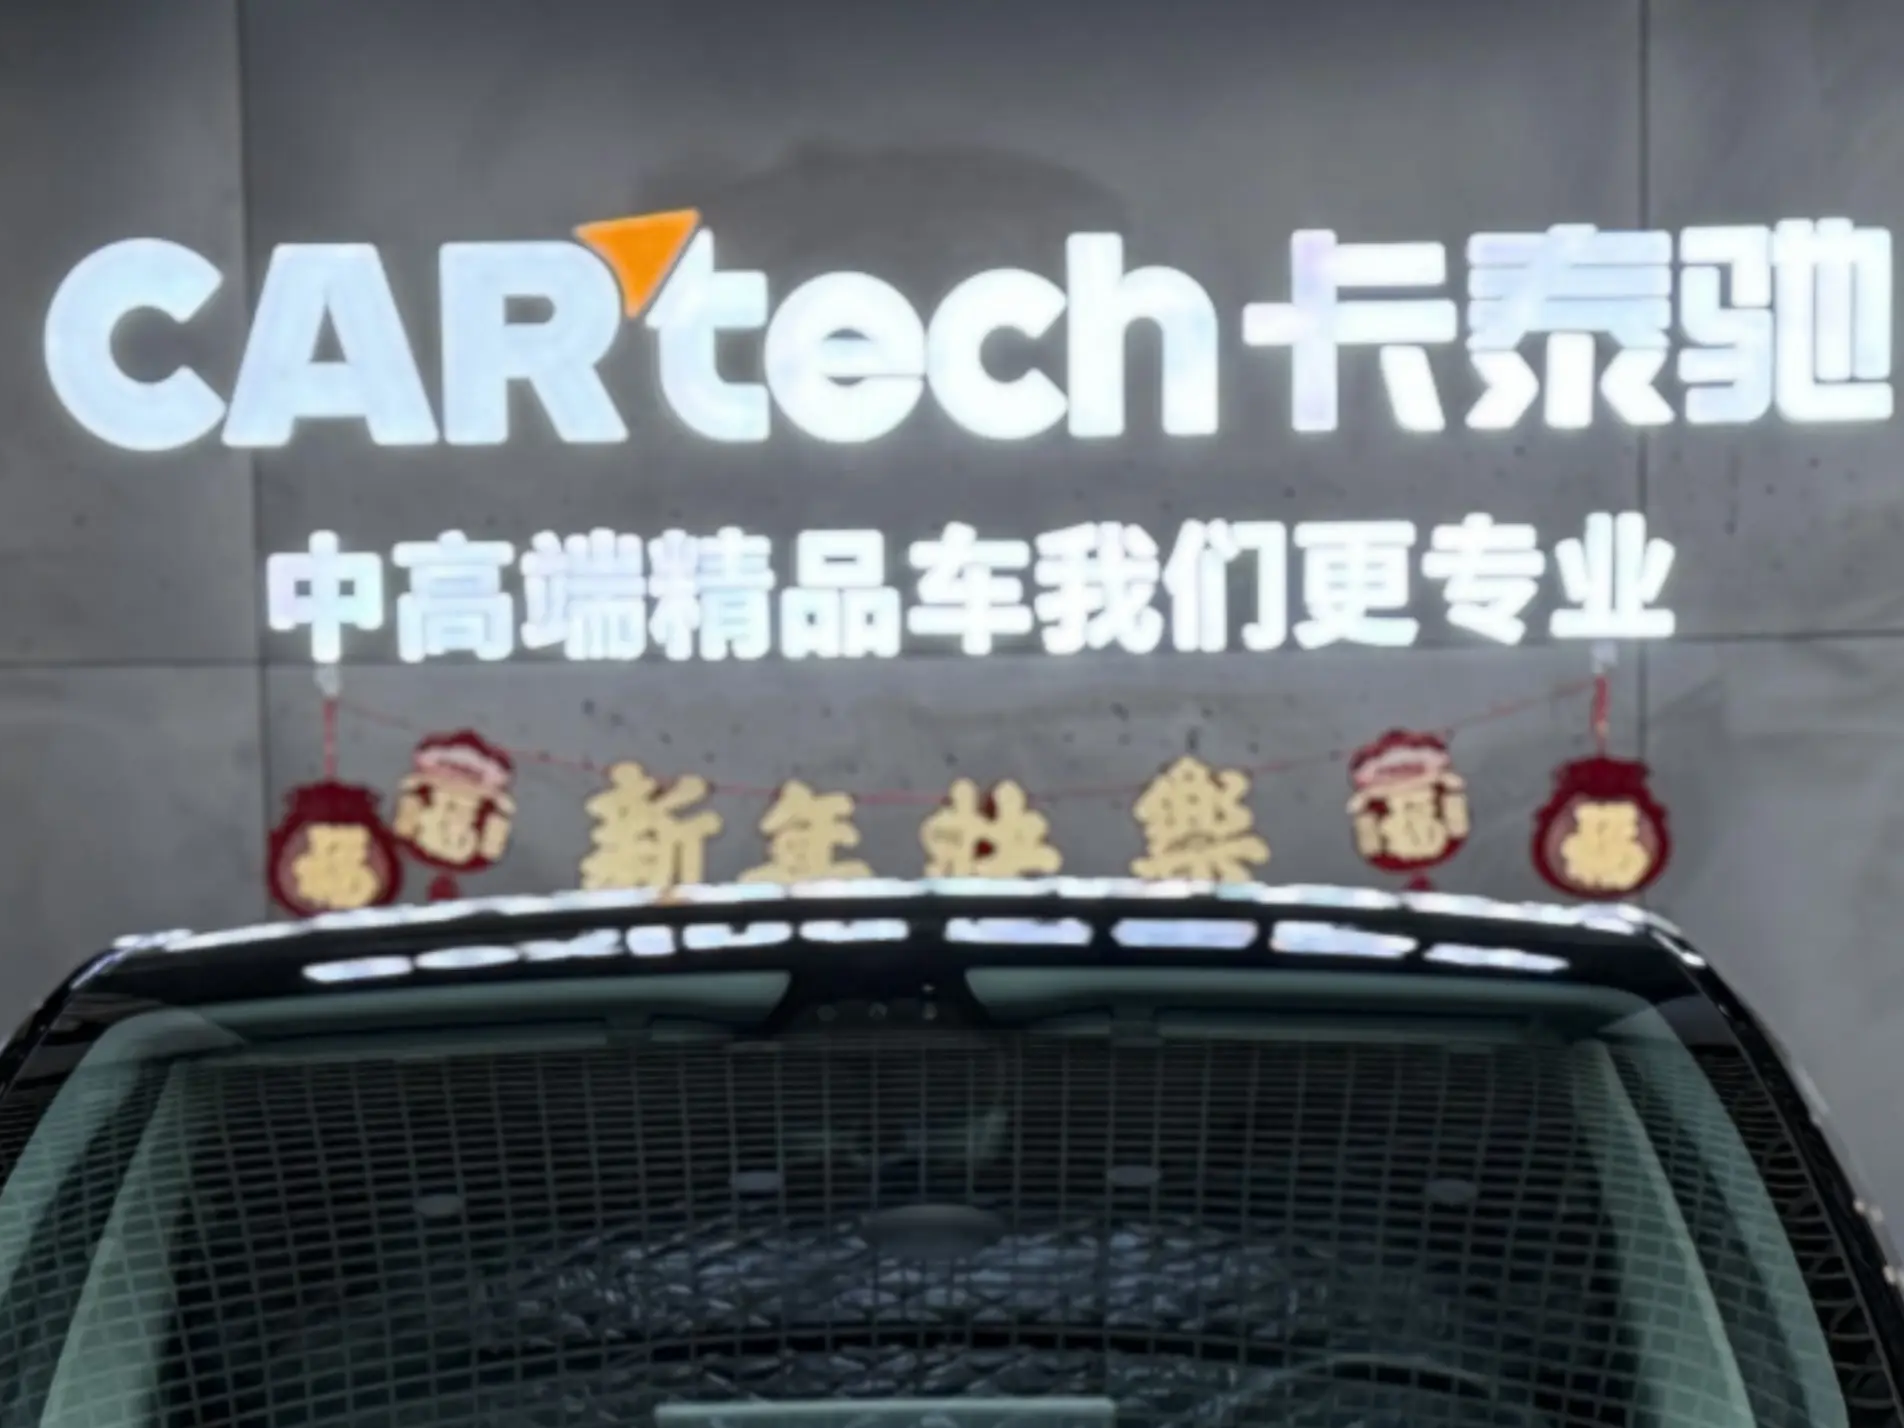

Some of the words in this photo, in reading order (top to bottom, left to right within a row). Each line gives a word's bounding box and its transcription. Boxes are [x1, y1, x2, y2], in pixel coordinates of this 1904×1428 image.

[43, 229, 1220, 452] CARtech
[1241, 216, 1896, 434] 卡泰驰
[266, 511, 1676, 665] 中高端精品车我们更专业
